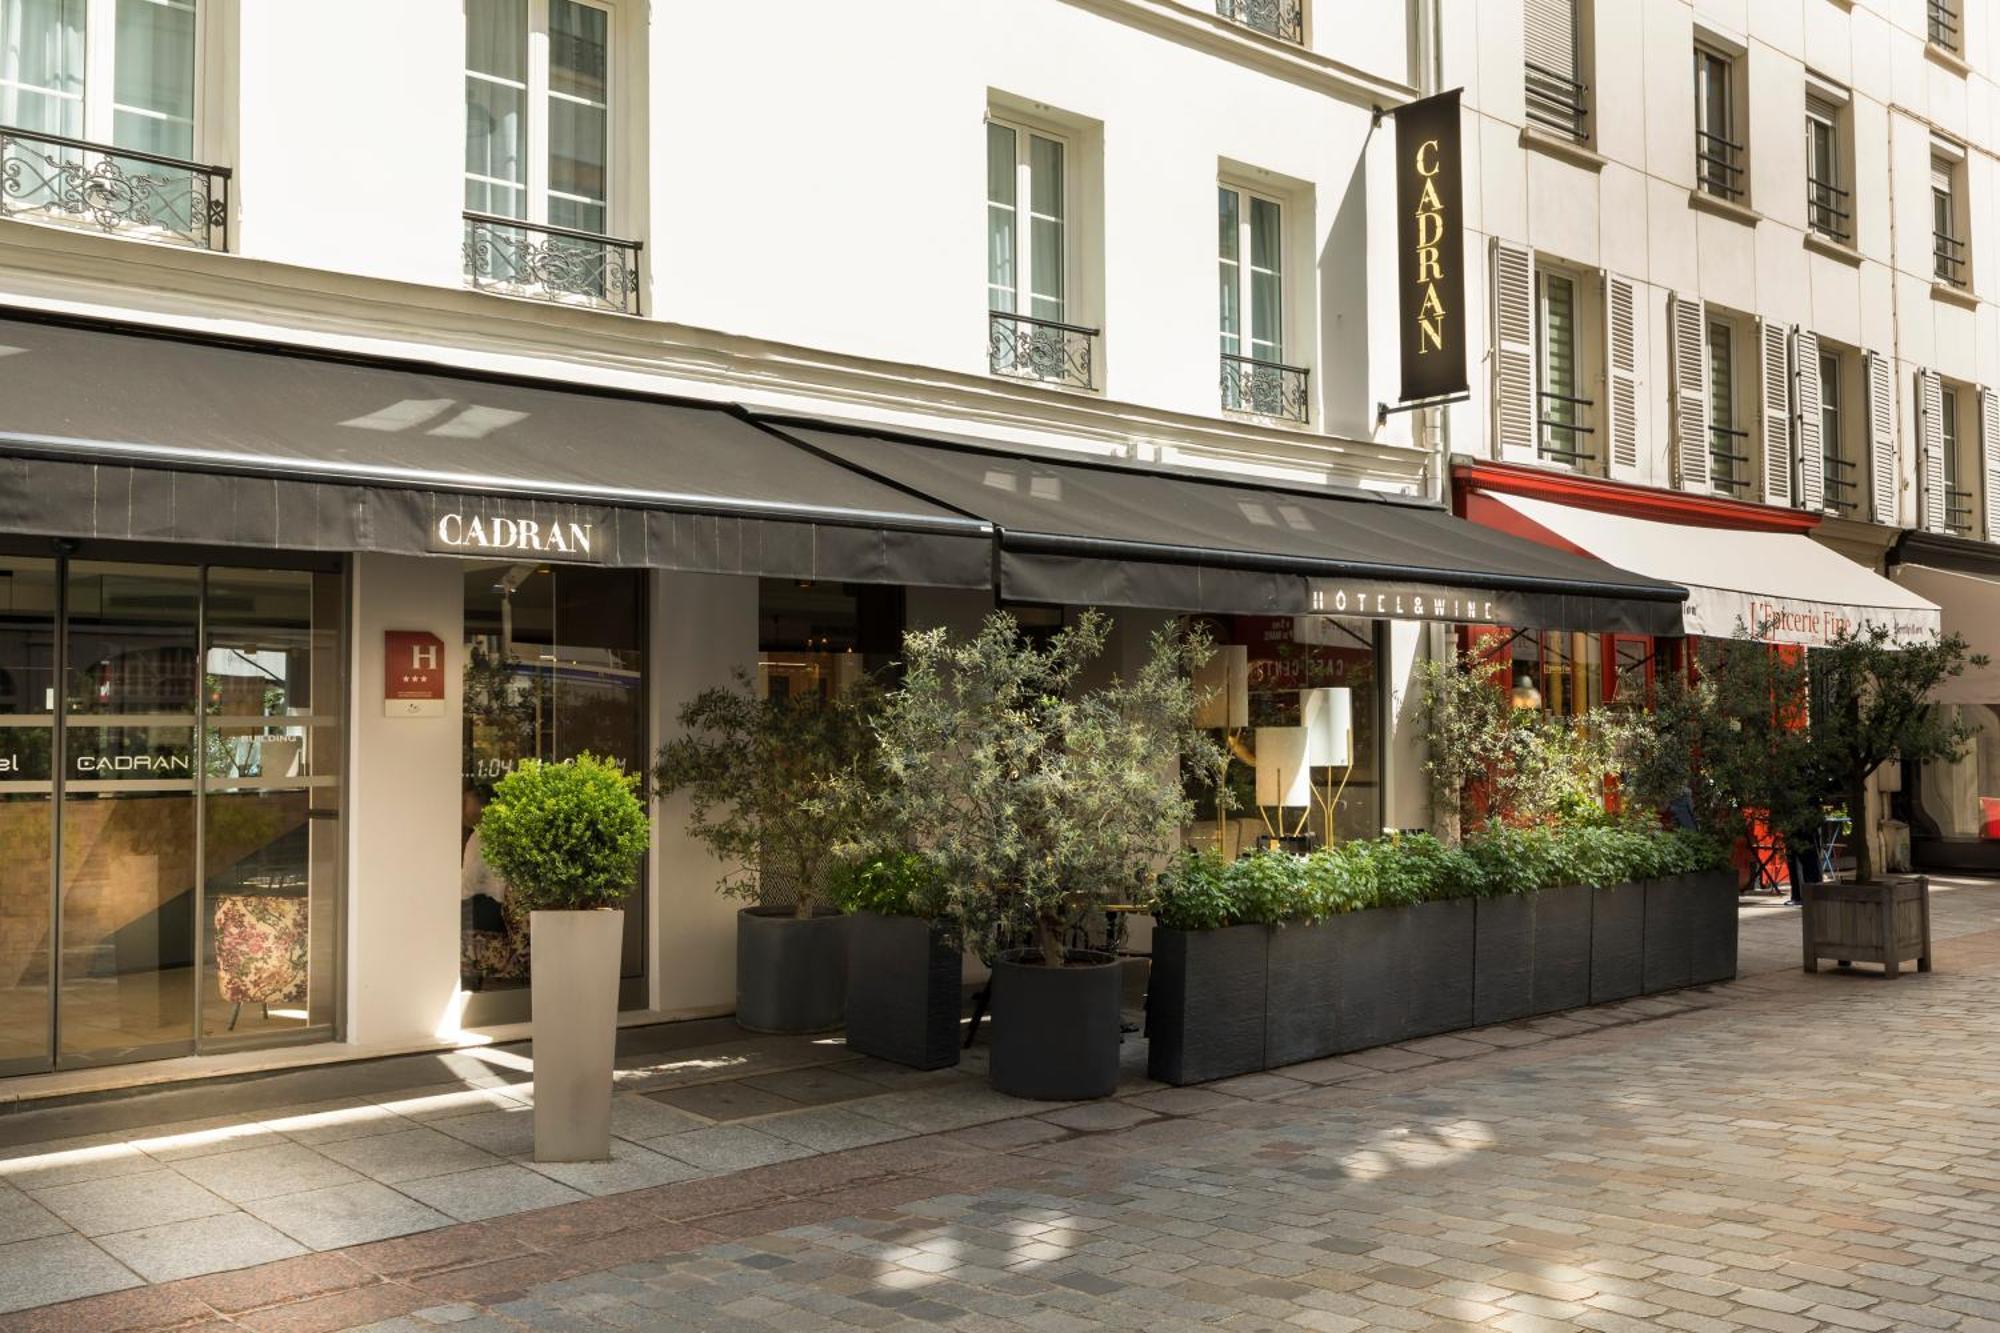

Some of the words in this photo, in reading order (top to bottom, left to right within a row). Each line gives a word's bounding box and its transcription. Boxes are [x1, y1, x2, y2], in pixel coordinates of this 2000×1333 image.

[1415, 139, 1446, 354] CADRAN
[438, 513, 593, 554] CADRAN
[412, 645, 438, 670] H
[76, 755, 190, 771] CADRAN
